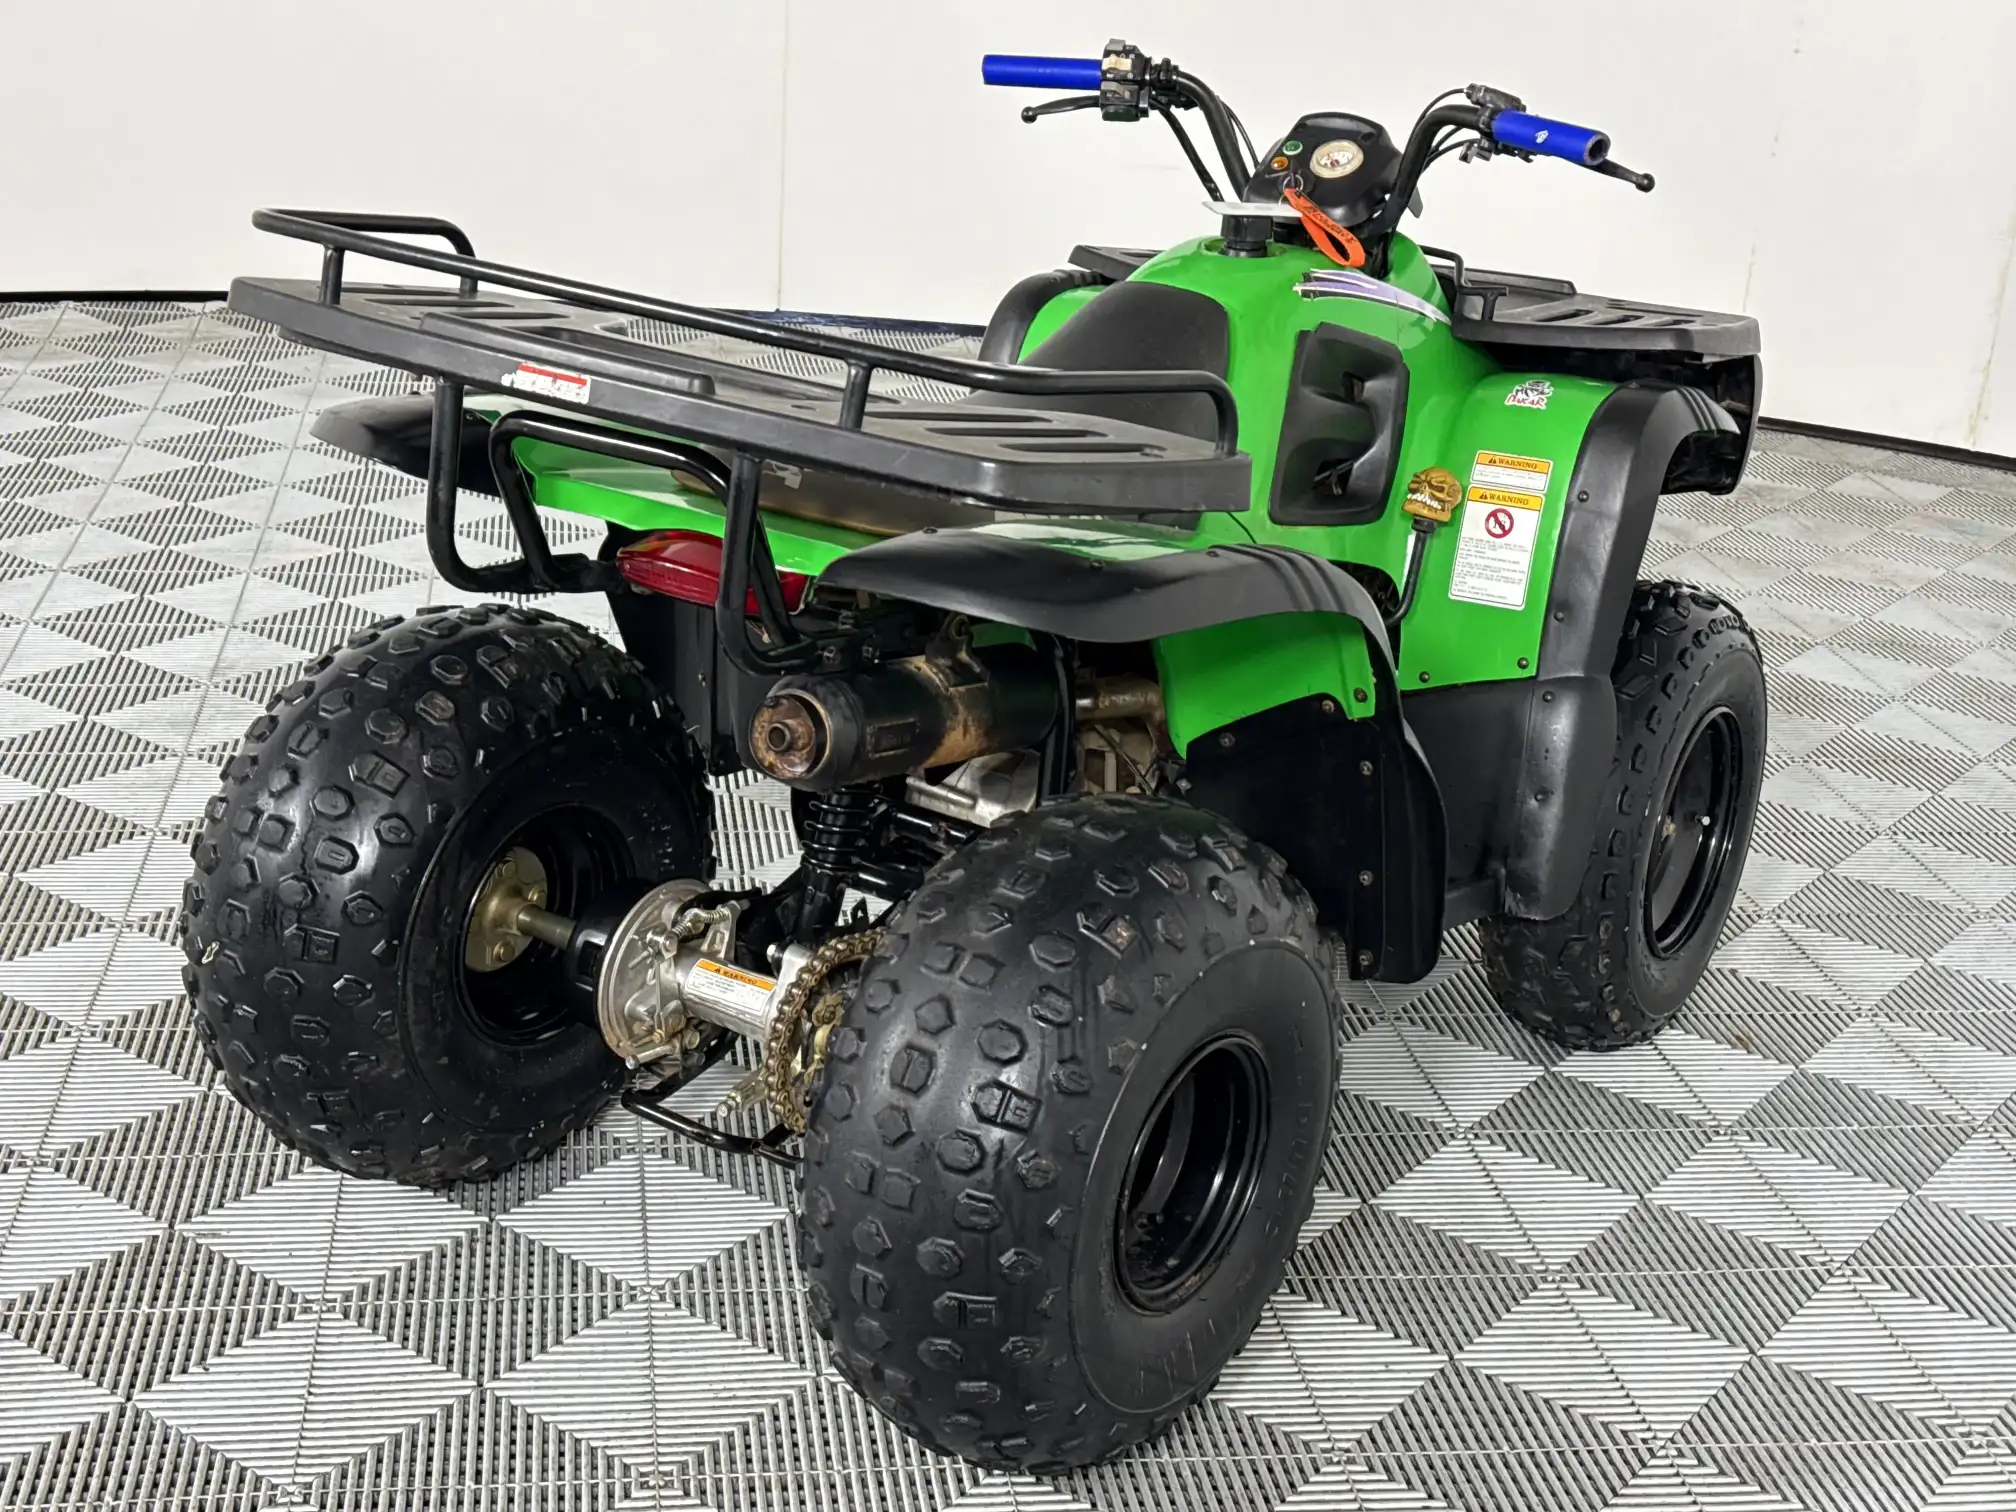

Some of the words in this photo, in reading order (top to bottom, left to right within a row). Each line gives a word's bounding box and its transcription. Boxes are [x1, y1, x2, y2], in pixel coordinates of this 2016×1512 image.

[1498, 458, 1538, 470] WARNING
[1487, 493, 1530, 506] WARNING
[722, 971, 758, 985] WARNING
